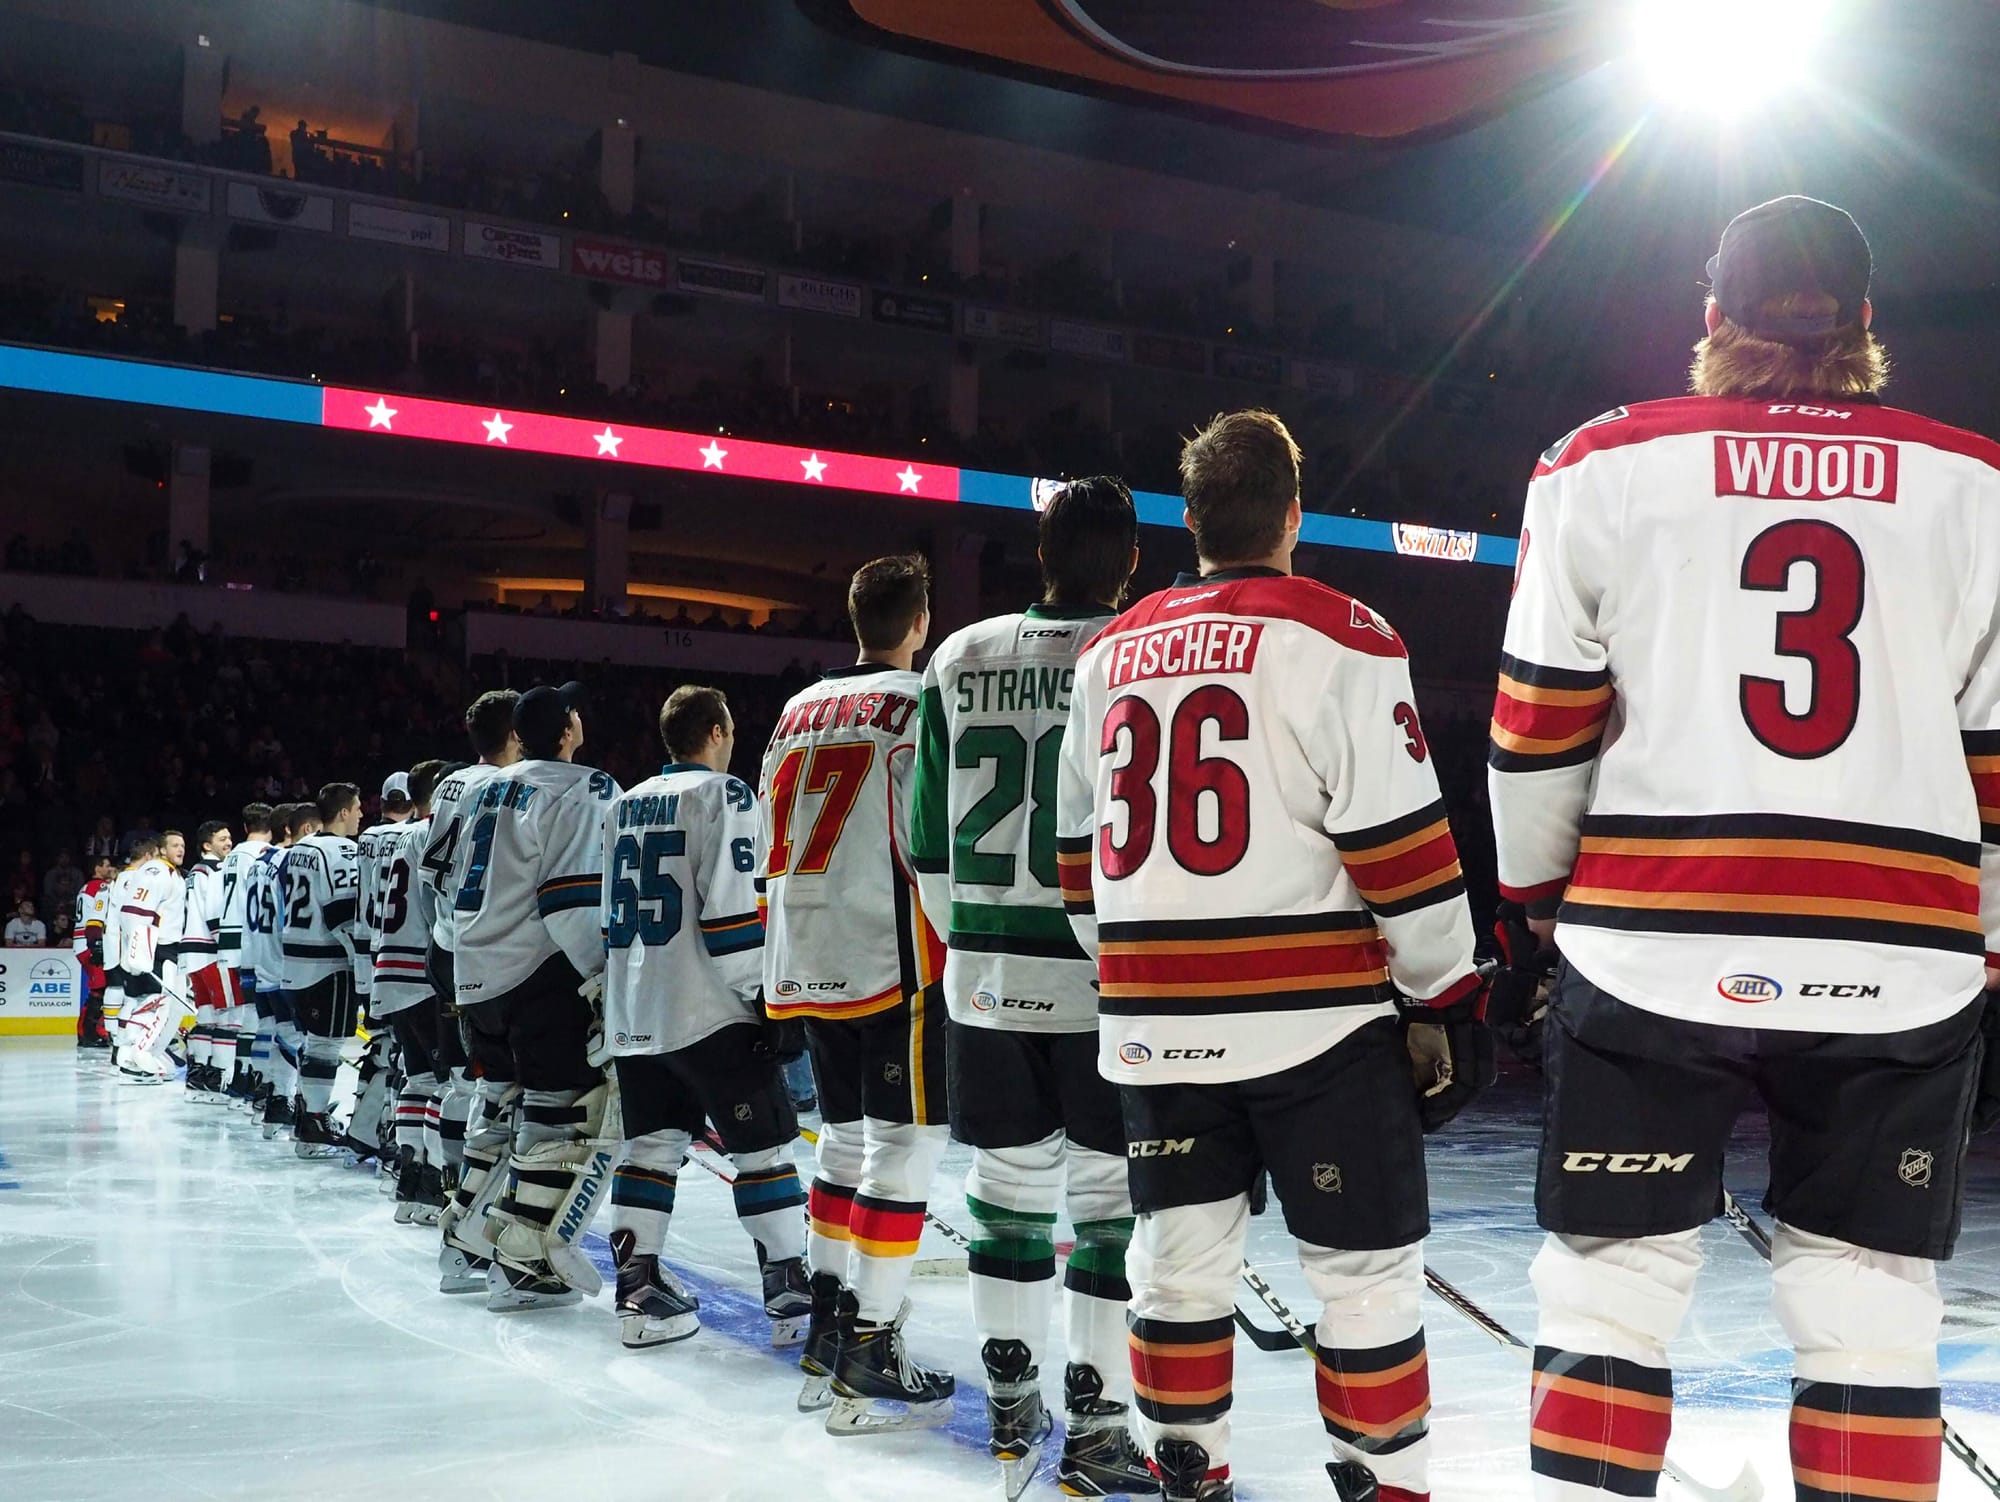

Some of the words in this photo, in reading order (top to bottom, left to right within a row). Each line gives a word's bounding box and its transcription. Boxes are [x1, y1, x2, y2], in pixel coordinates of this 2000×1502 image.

[575, 248, 662, 281] weis
[1768, 405, 1852, 419] CCM
[1725, 438, 1886, 496] WOOD
[1401, 533, 1469, 558] SKILLS
[664, 630, 692, 648] 116
[1021, 629, 1071, 639] CCM
[1740, 518, 1865, 760] 3
[1114, 623, 1252, 685] FISCHER
[1393, 701, 1428, 764] 3
[1100, 684, 1250, 881] 36
[766, 741, 875, 880] 17
[133, 887, 149, 902] 31
[608, 830, 686, 948] 65
[30, 982, 71, 994] ABE
[459, 983, 483, 991] CCM
[807, 981, 848, 990] CCM
[1799, 983, 1881, 998] CCM
[1001, 998, 1055, 1012] CCM
[630, 1034, 652, 1042] CCM
[1162, 1048, 1227, 1060] CCM
[1128, 1137, 1195, 1159] CCM
[1563, 1151, 1695, 1173] CCM
[557, 1151, 613, 1244] VAUGHN
[1240, 1265, 1307, 1337] CCM
